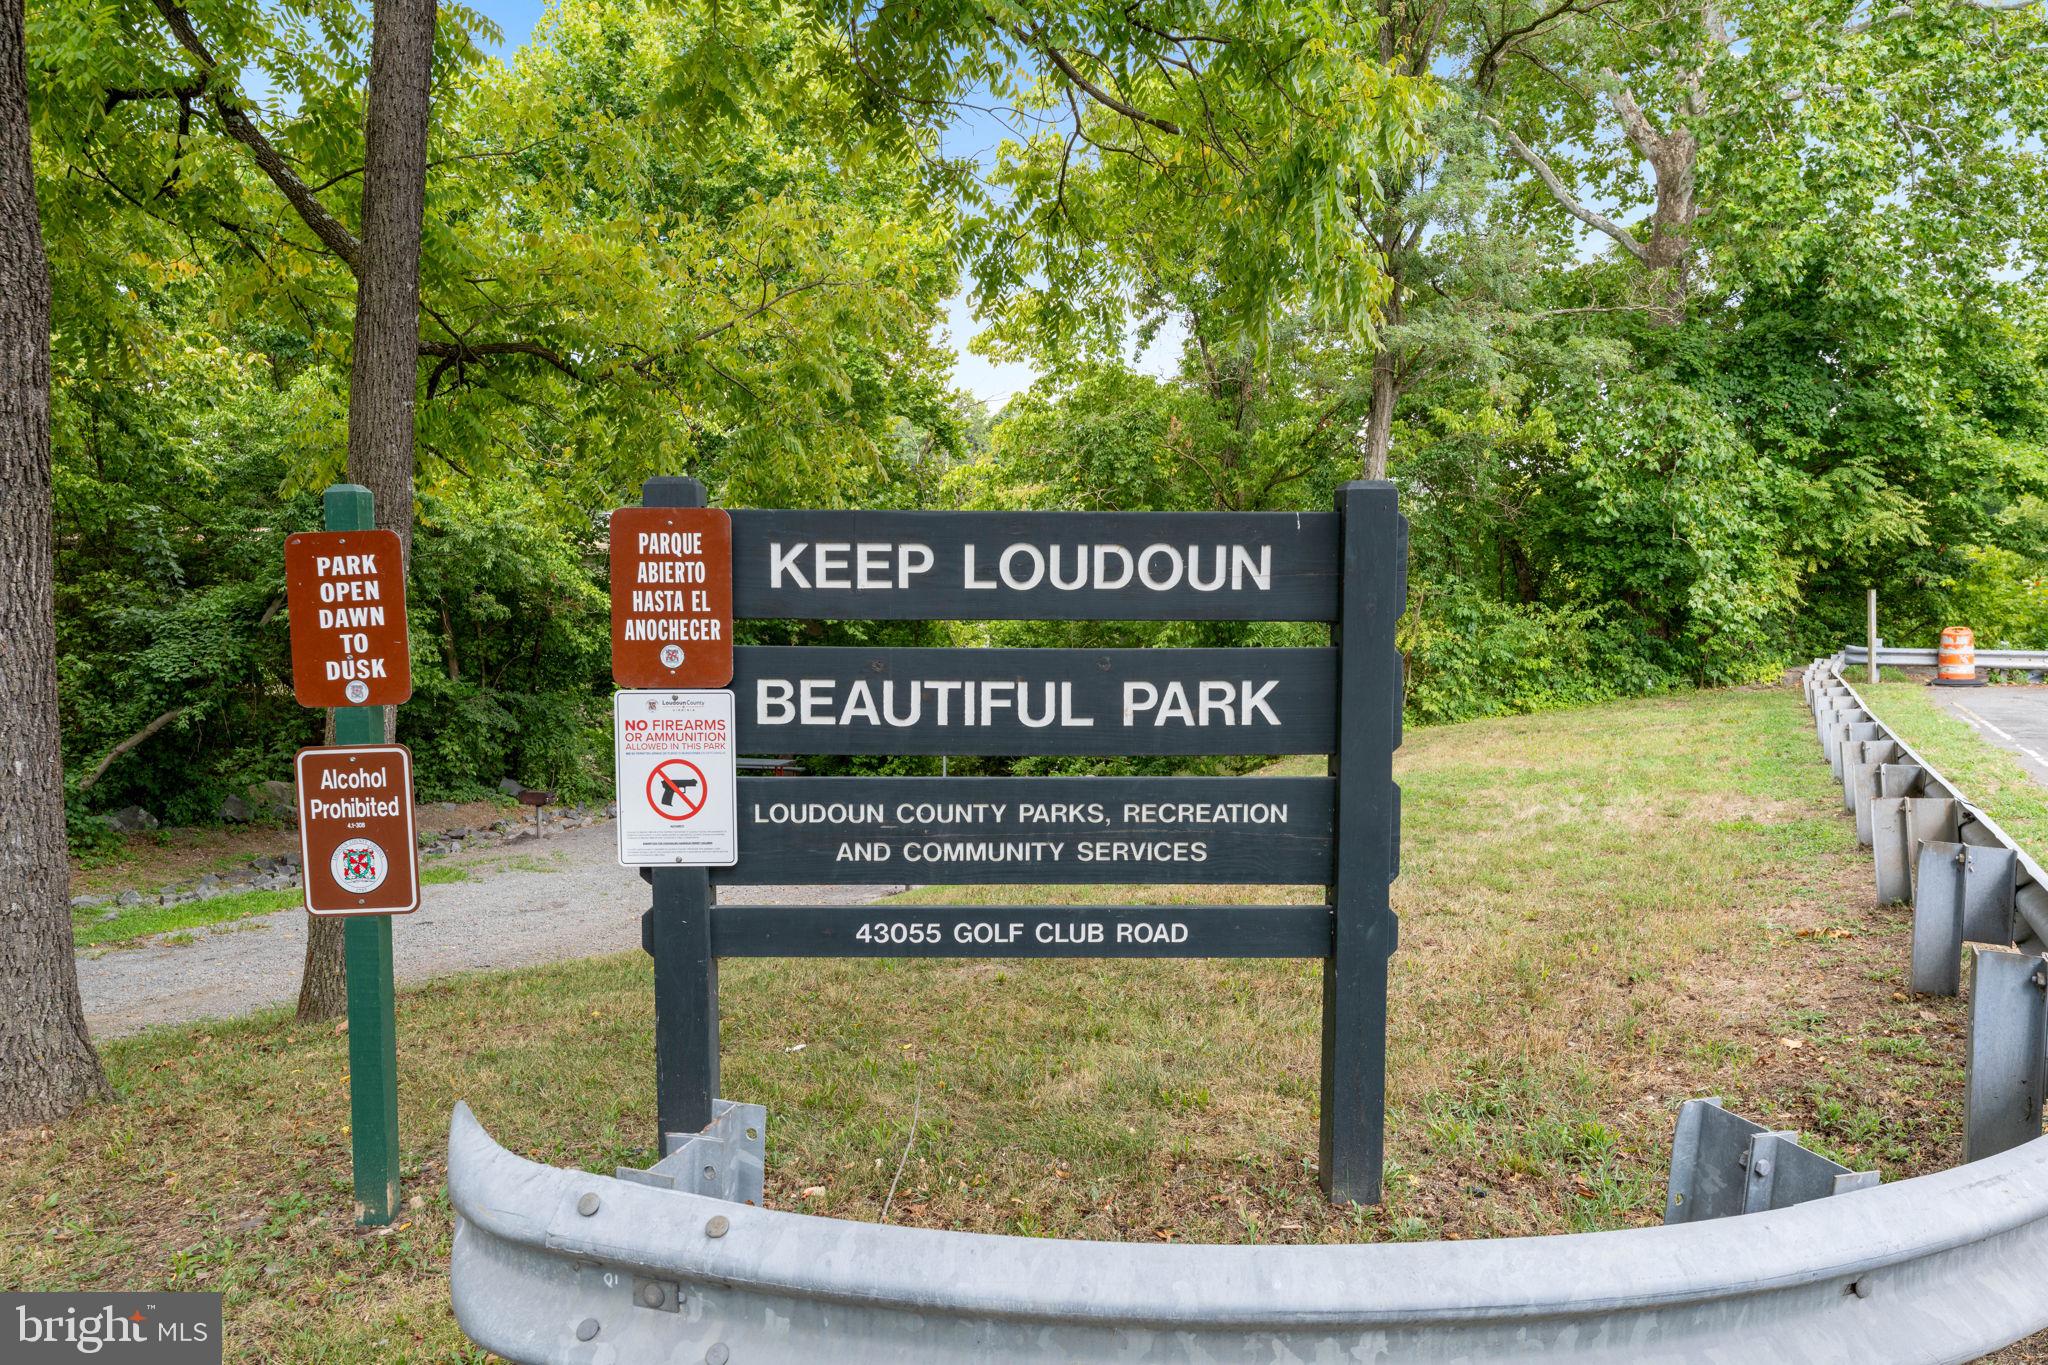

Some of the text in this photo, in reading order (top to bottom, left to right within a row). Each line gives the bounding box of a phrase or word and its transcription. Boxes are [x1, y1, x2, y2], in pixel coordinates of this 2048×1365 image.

[639, 533, 702, 557] PARQUE
[317, 555, 377, 576] PARK
[638, 562, 705, 583] ABIERTO
[771, 543, 1271, 591] KEEP LOUDOUN
[320, 581, 379, 602] OPEN
[633, 591, 710, 612] HASTA EL
[319, 607, 384, 628] DAWN
[625, 619, 720, 640] ANOCHECER
[340, 634, 368, 653] TO
[326, 659, 387, 681] DUSK
[757, 679, 1281, 727] BEAUTIFUL PARK
[625, 719, 726, 731] NO FIREARMS
[625, 732, 726, 742] OR AMMUNITION
[625, 743, 668, 751] ALLOWED
[703, 742, 726, 750] PARK
[321, 767, 386, 789] Alcohol
[311, 796, 399, 819] Prohibited
[755, 804, 1287, 825] LOUDOUN COUNTY PARKS, RECREATION
[836, 842, 1207, 861] AND COMMUNITY SERVICES
[856, 923, 1188, 943] 43055 GOLF CLUB ROAD
